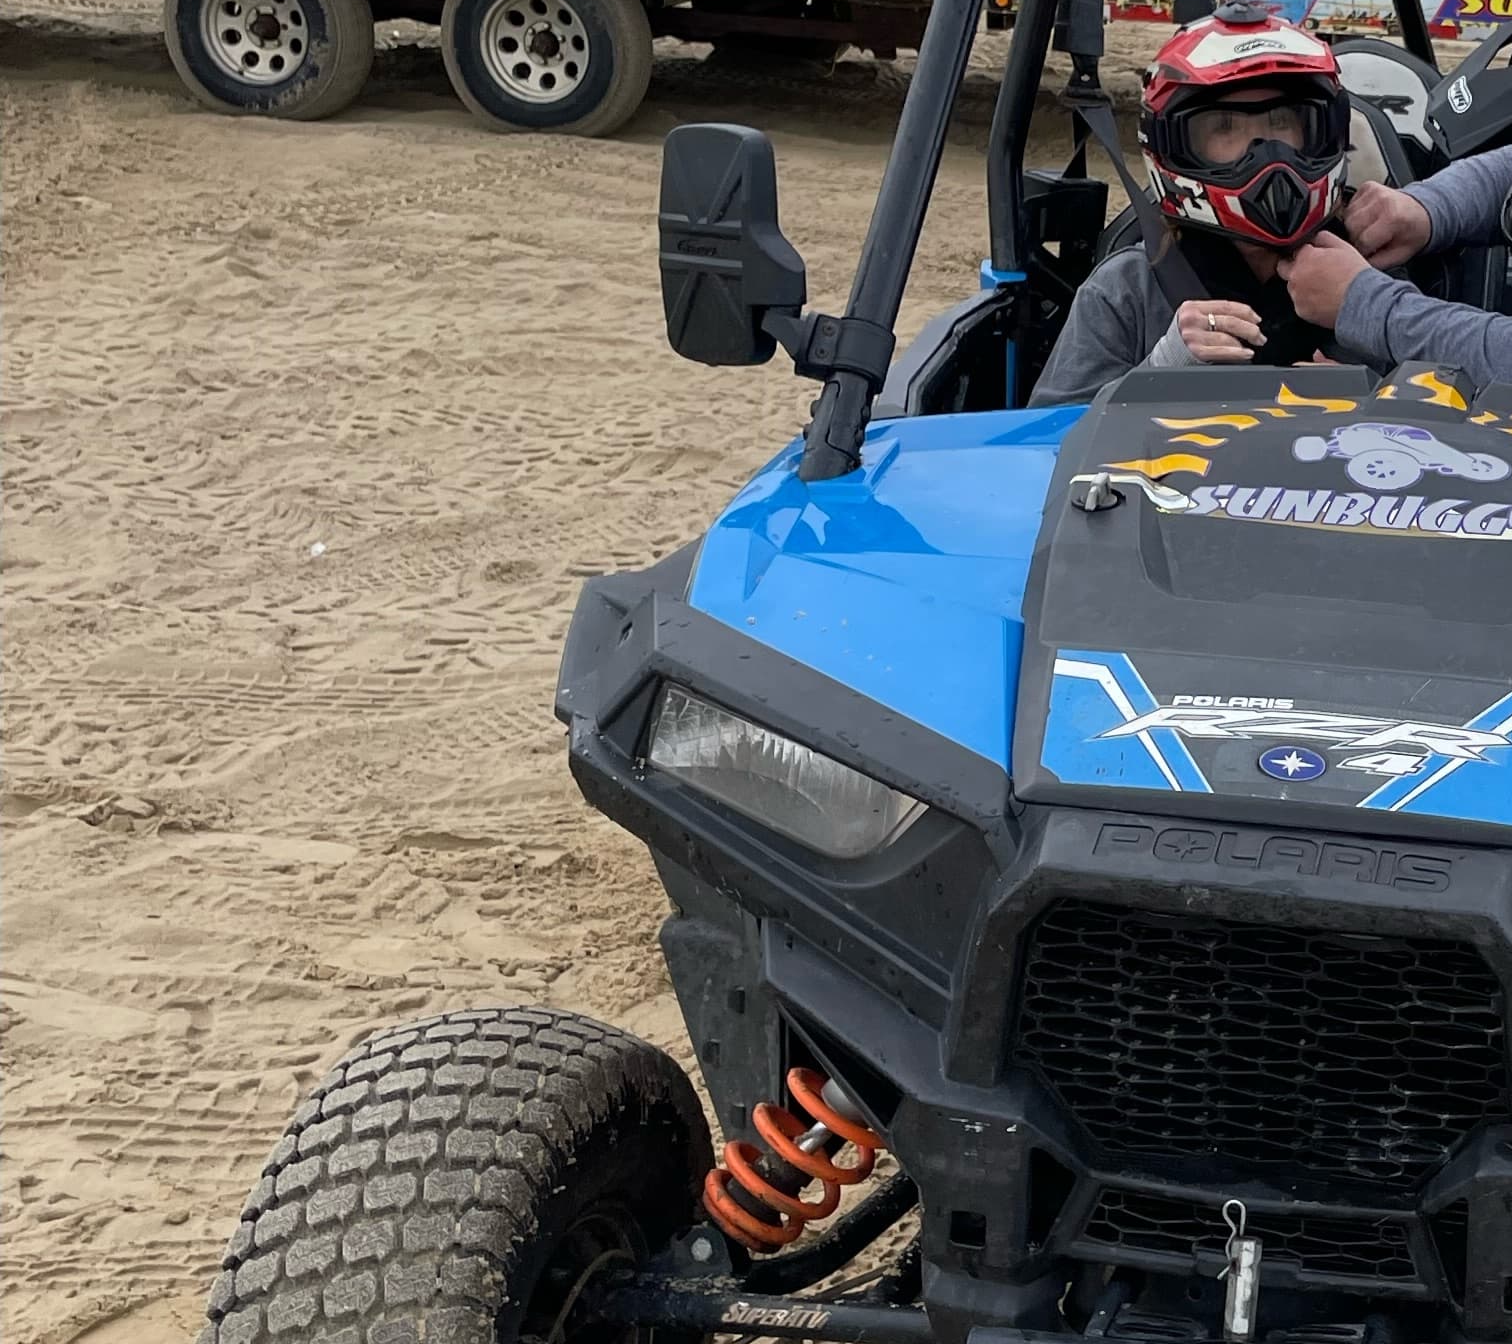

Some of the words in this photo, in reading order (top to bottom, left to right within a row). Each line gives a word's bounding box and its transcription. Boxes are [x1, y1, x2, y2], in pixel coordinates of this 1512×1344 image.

[1172, 695, 1294, 710] POLARIS
[1336, 752, 1428, 777] 4
[1093, 822, 1453, 894] POLARIS
